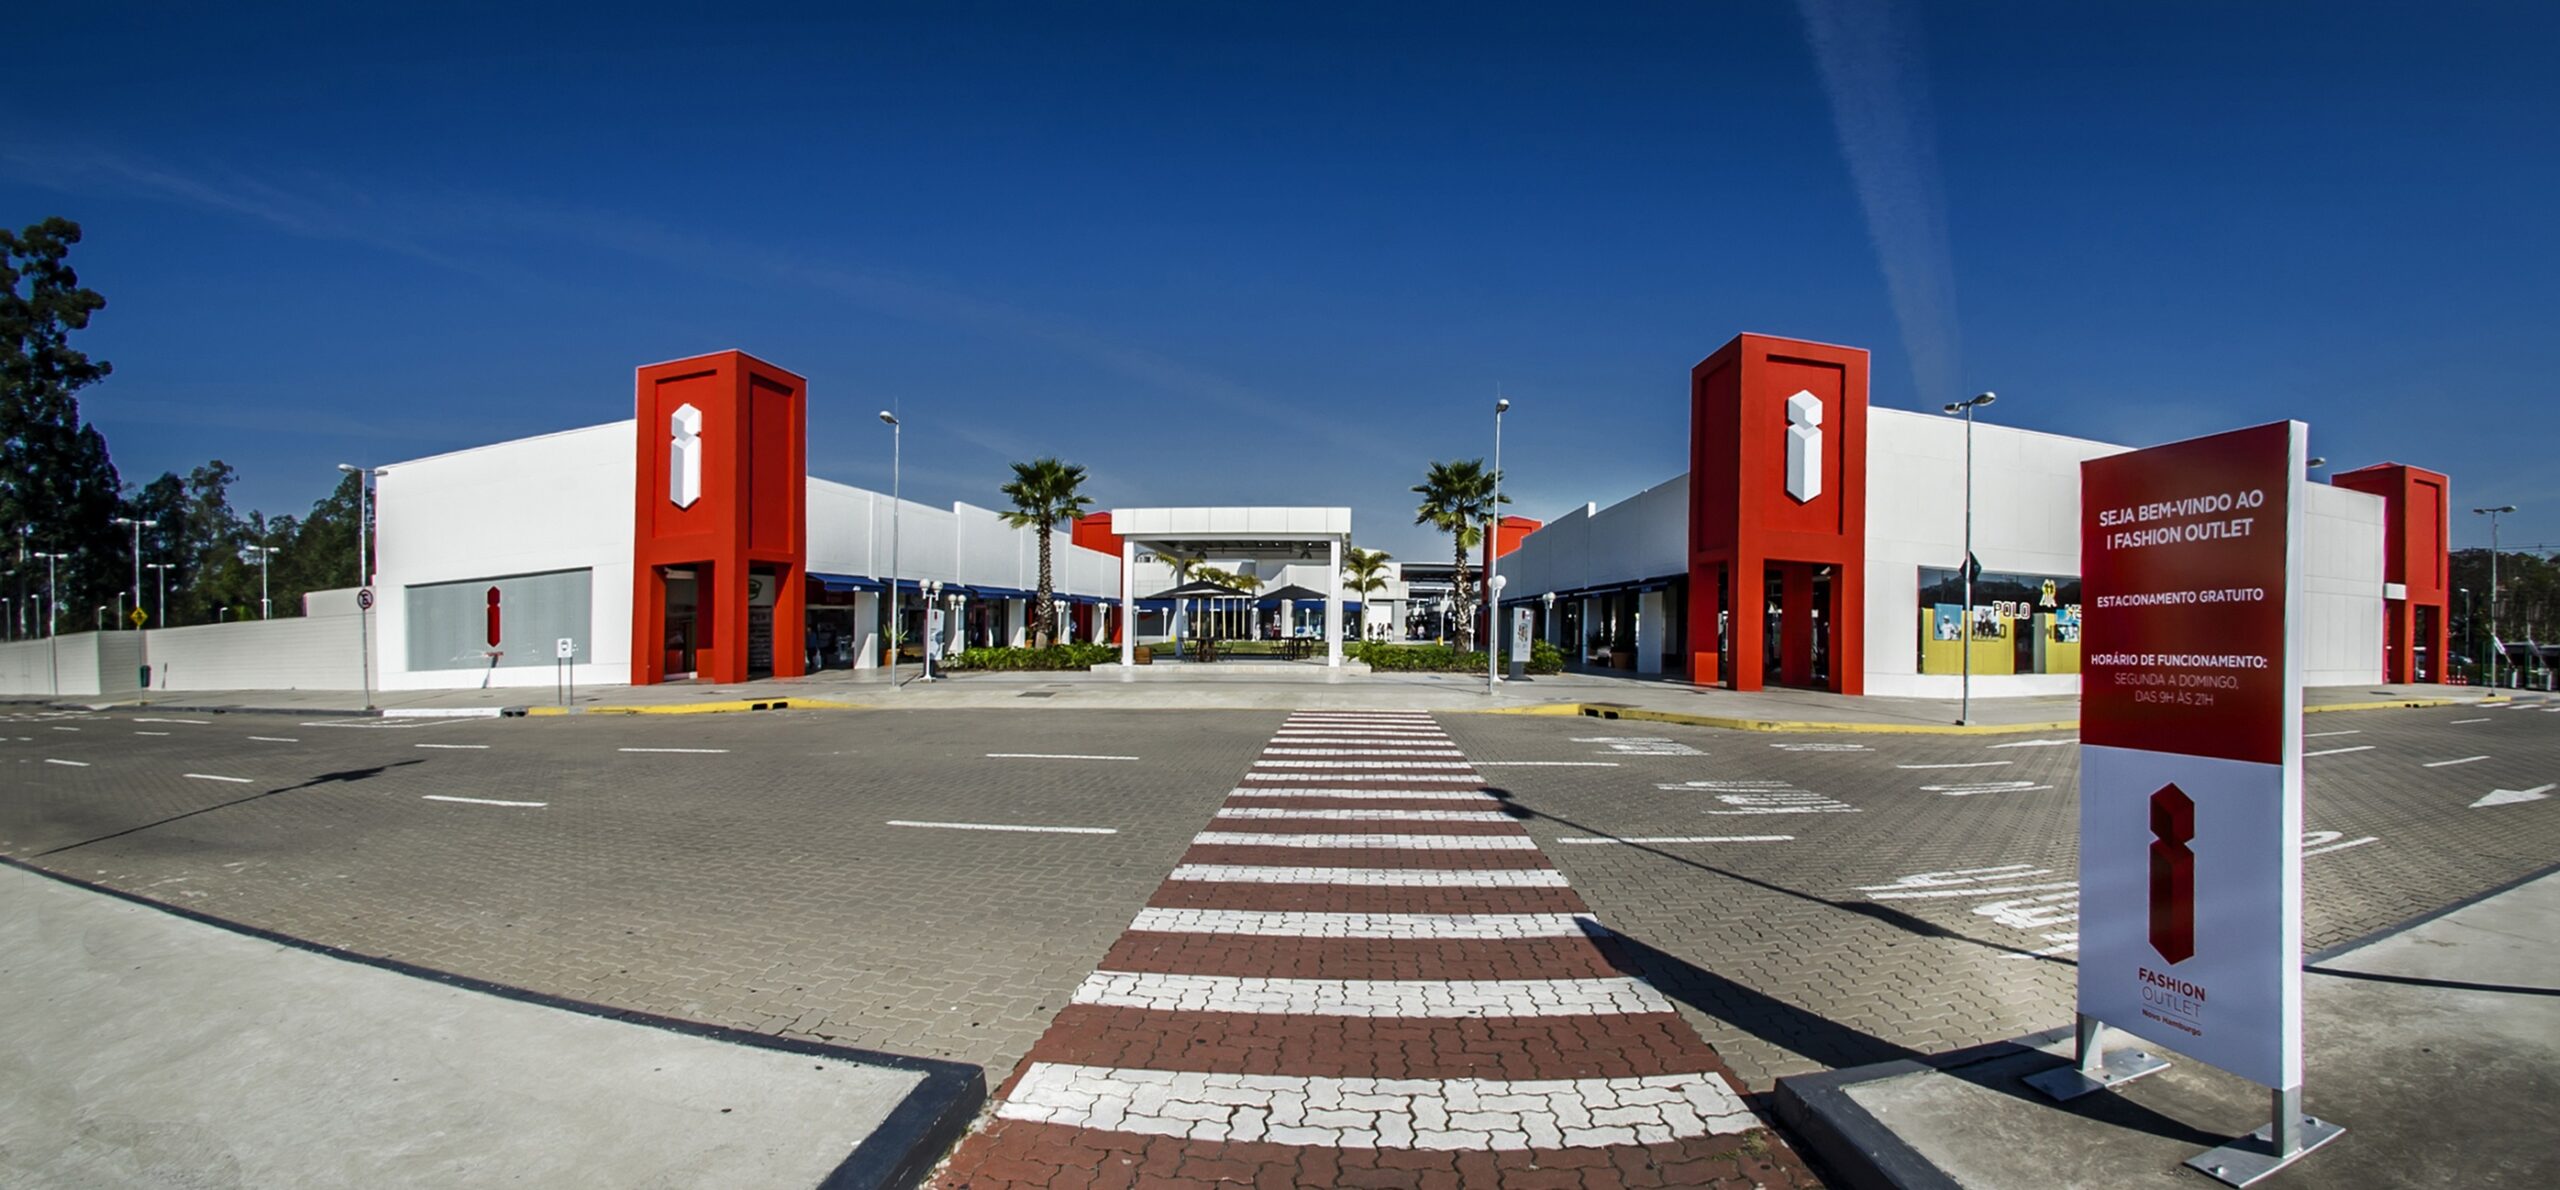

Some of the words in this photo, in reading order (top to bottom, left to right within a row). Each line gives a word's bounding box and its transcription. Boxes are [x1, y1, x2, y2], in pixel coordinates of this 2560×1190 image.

[2099, 509, 2135, 527] SEJA
[2138, 493, 2232, 523] BEM-VINDO
[2235, 489, 2264, 510] AO
[2114, 526, 2182, 550] FASHION
[2185, 518, 2254, 542] OUTLET
[2096, 591, 2197, 608] ESTACIONAMENTO
[2199, 588, 2264, 603] GRATUITO
[1993, 601, 2031, 619] POLO
[2091, 651, 2138, 666] HORÁRIO
[2140, 655, 2155, 667] DE
[2157, 654, 2268, 669] FUNCIONAMENTO:
[2114, 672, 2165, 686] SEGUNDA
[2168, 675, 2177, 686] A
[2178, 674, 2239, 690] DOMINGO,
[2135, 690, 2157, 704] DAS
[2159, 692, 2174, 704] 9H
[2195, 693, 2213, 706] 21H
[2138, 967, 2206, 1002] FASHION
[2142, 986, 2202, 1018] OUTLET
